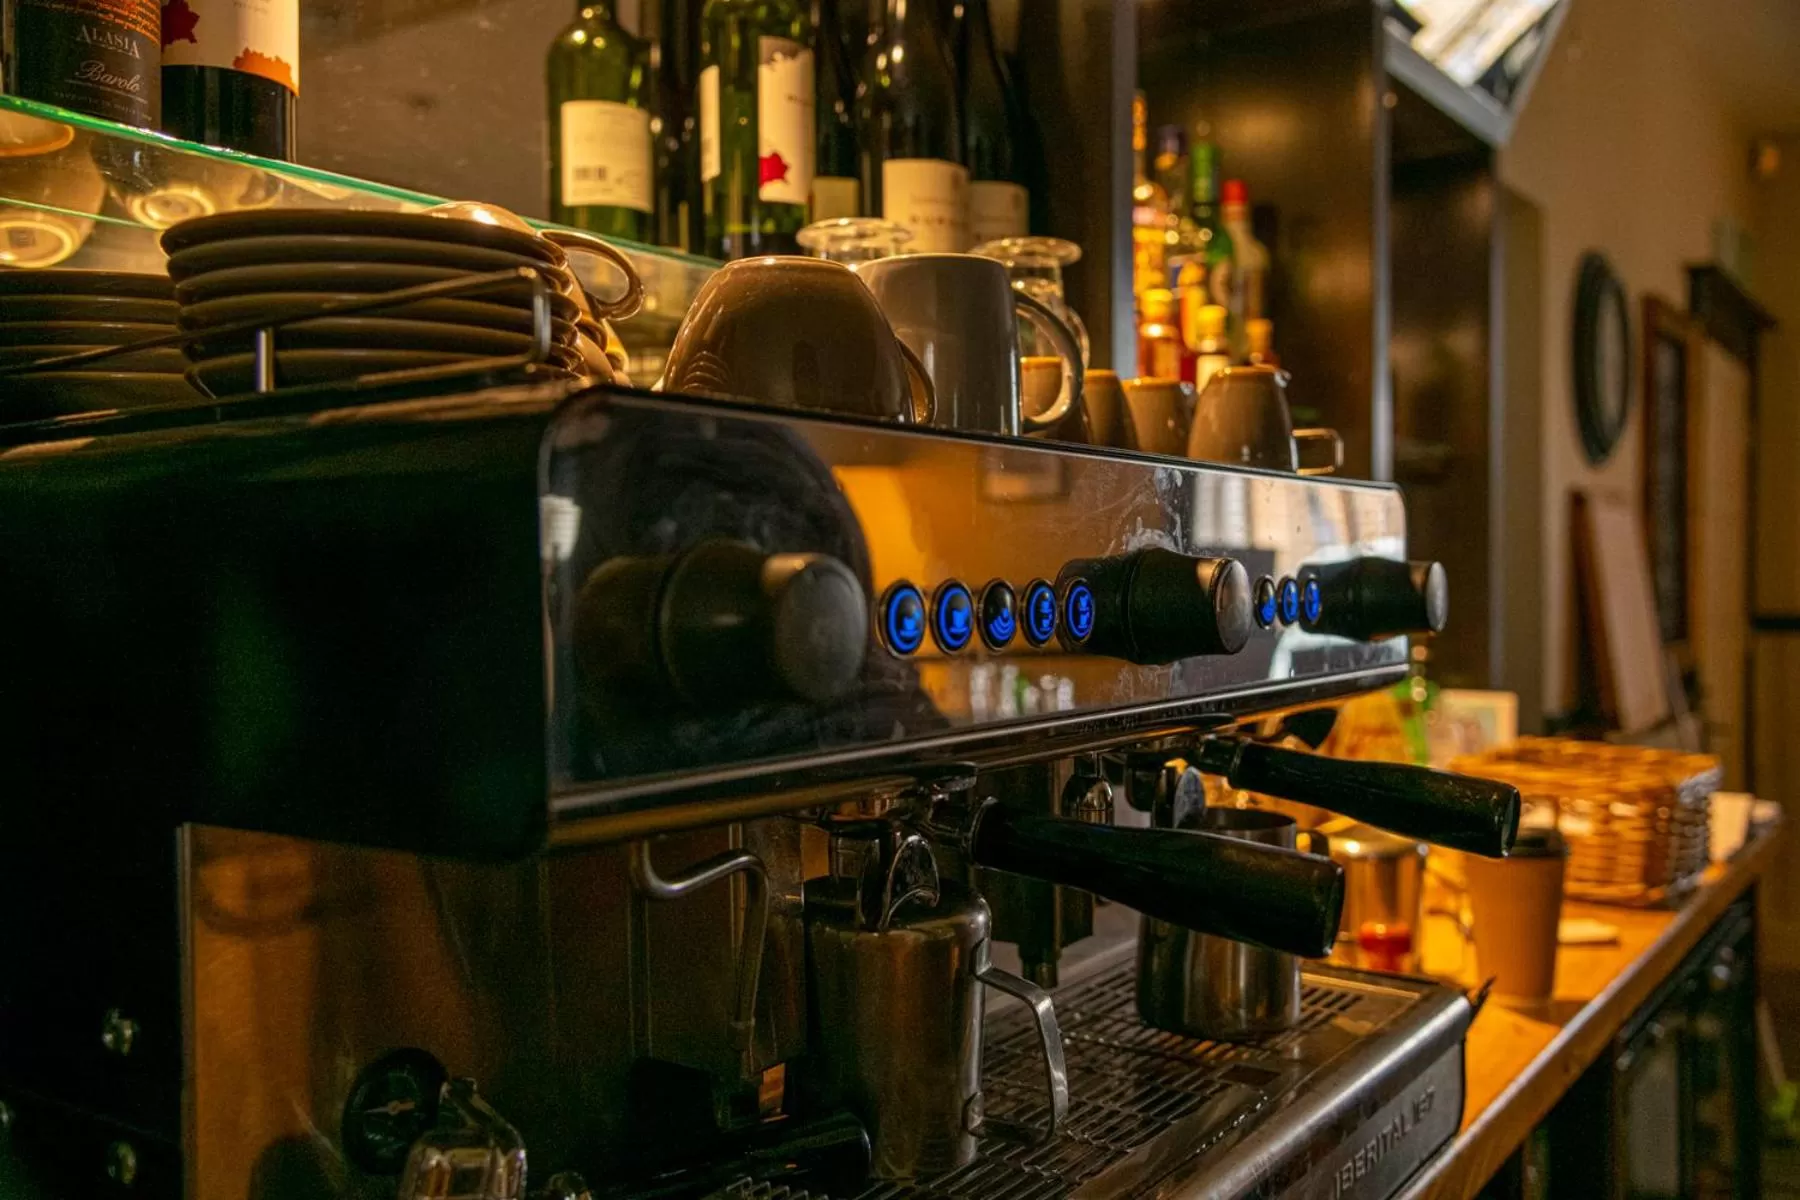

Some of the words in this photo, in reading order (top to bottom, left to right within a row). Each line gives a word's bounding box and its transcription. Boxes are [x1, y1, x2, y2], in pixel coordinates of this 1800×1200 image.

[75, 24, 140, 59] ALASIA
[75, 60, 142, 93] Barolo
[1334, 1110, 1411, 1200] IBERITAL
